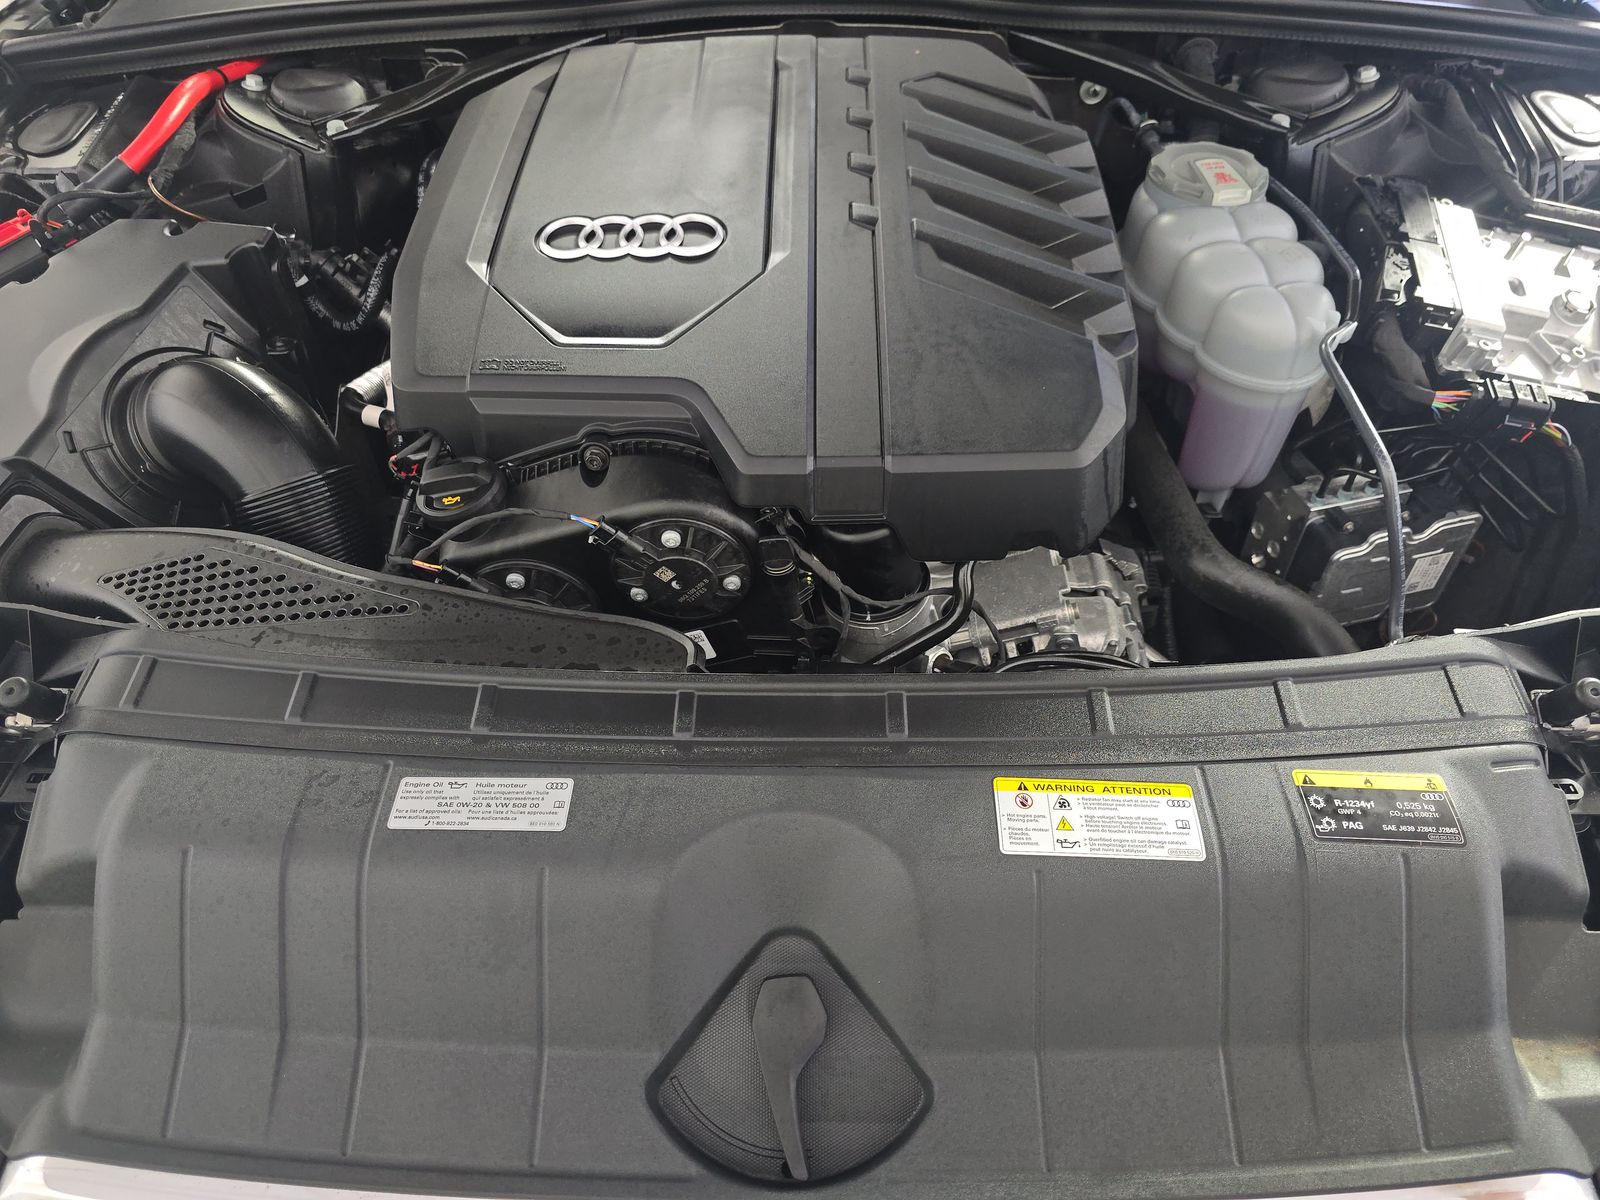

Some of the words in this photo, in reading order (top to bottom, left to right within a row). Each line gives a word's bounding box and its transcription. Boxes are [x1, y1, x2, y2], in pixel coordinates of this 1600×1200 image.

[1033, 783, 1095, 792] WARNING
[1102, 786, 1171, 795] ATTENTION
[1334, 799, 1375, 809] R-1234yf
[1396, 802, 1421, 810] 0,525
[1422, 803, 1436, 811] kg
[1342, 821, 1363, 830] PAG
